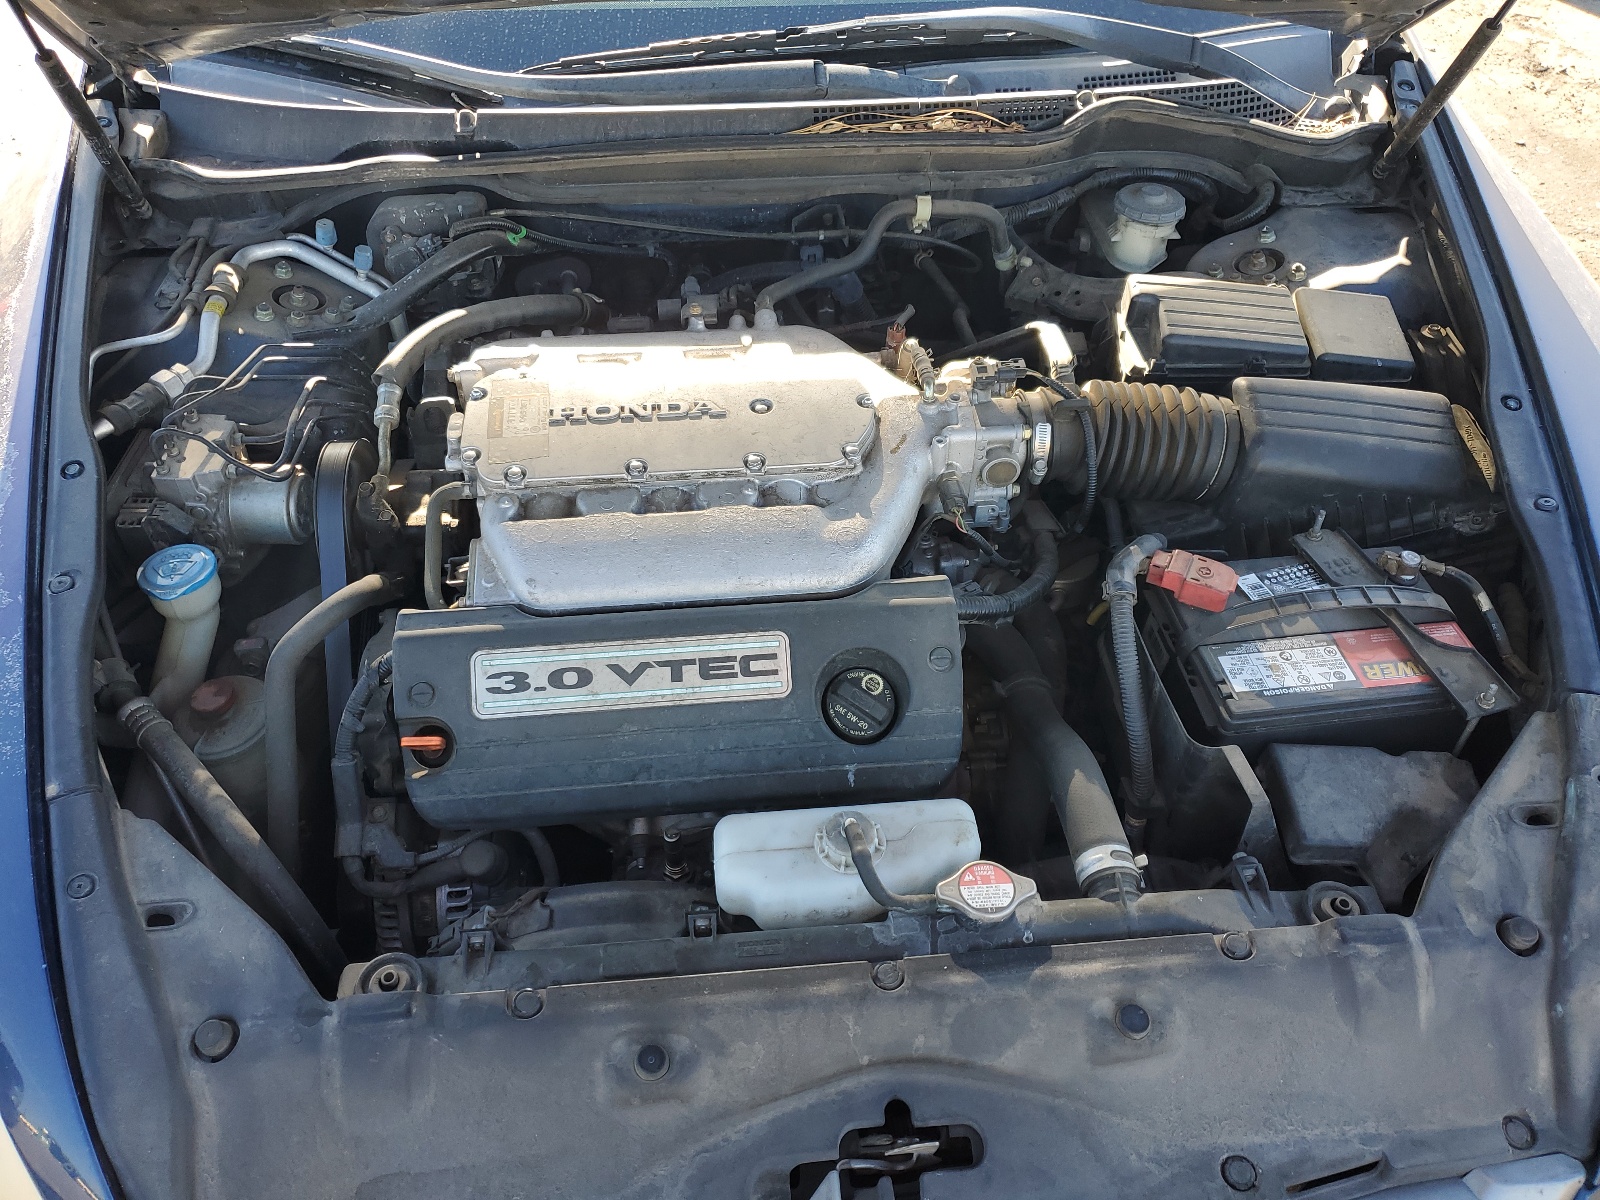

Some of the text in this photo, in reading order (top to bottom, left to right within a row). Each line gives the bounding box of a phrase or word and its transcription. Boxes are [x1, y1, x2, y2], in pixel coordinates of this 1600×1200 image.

[549, 401, 727, 426] HONDA
[485, 653, 779, 695] 3.0 VTEC
[1363, 661, 1425, 681] WER
[884, 689, 892, 702] OIL
[834, 704, 868, 730] SAE 5W-20
